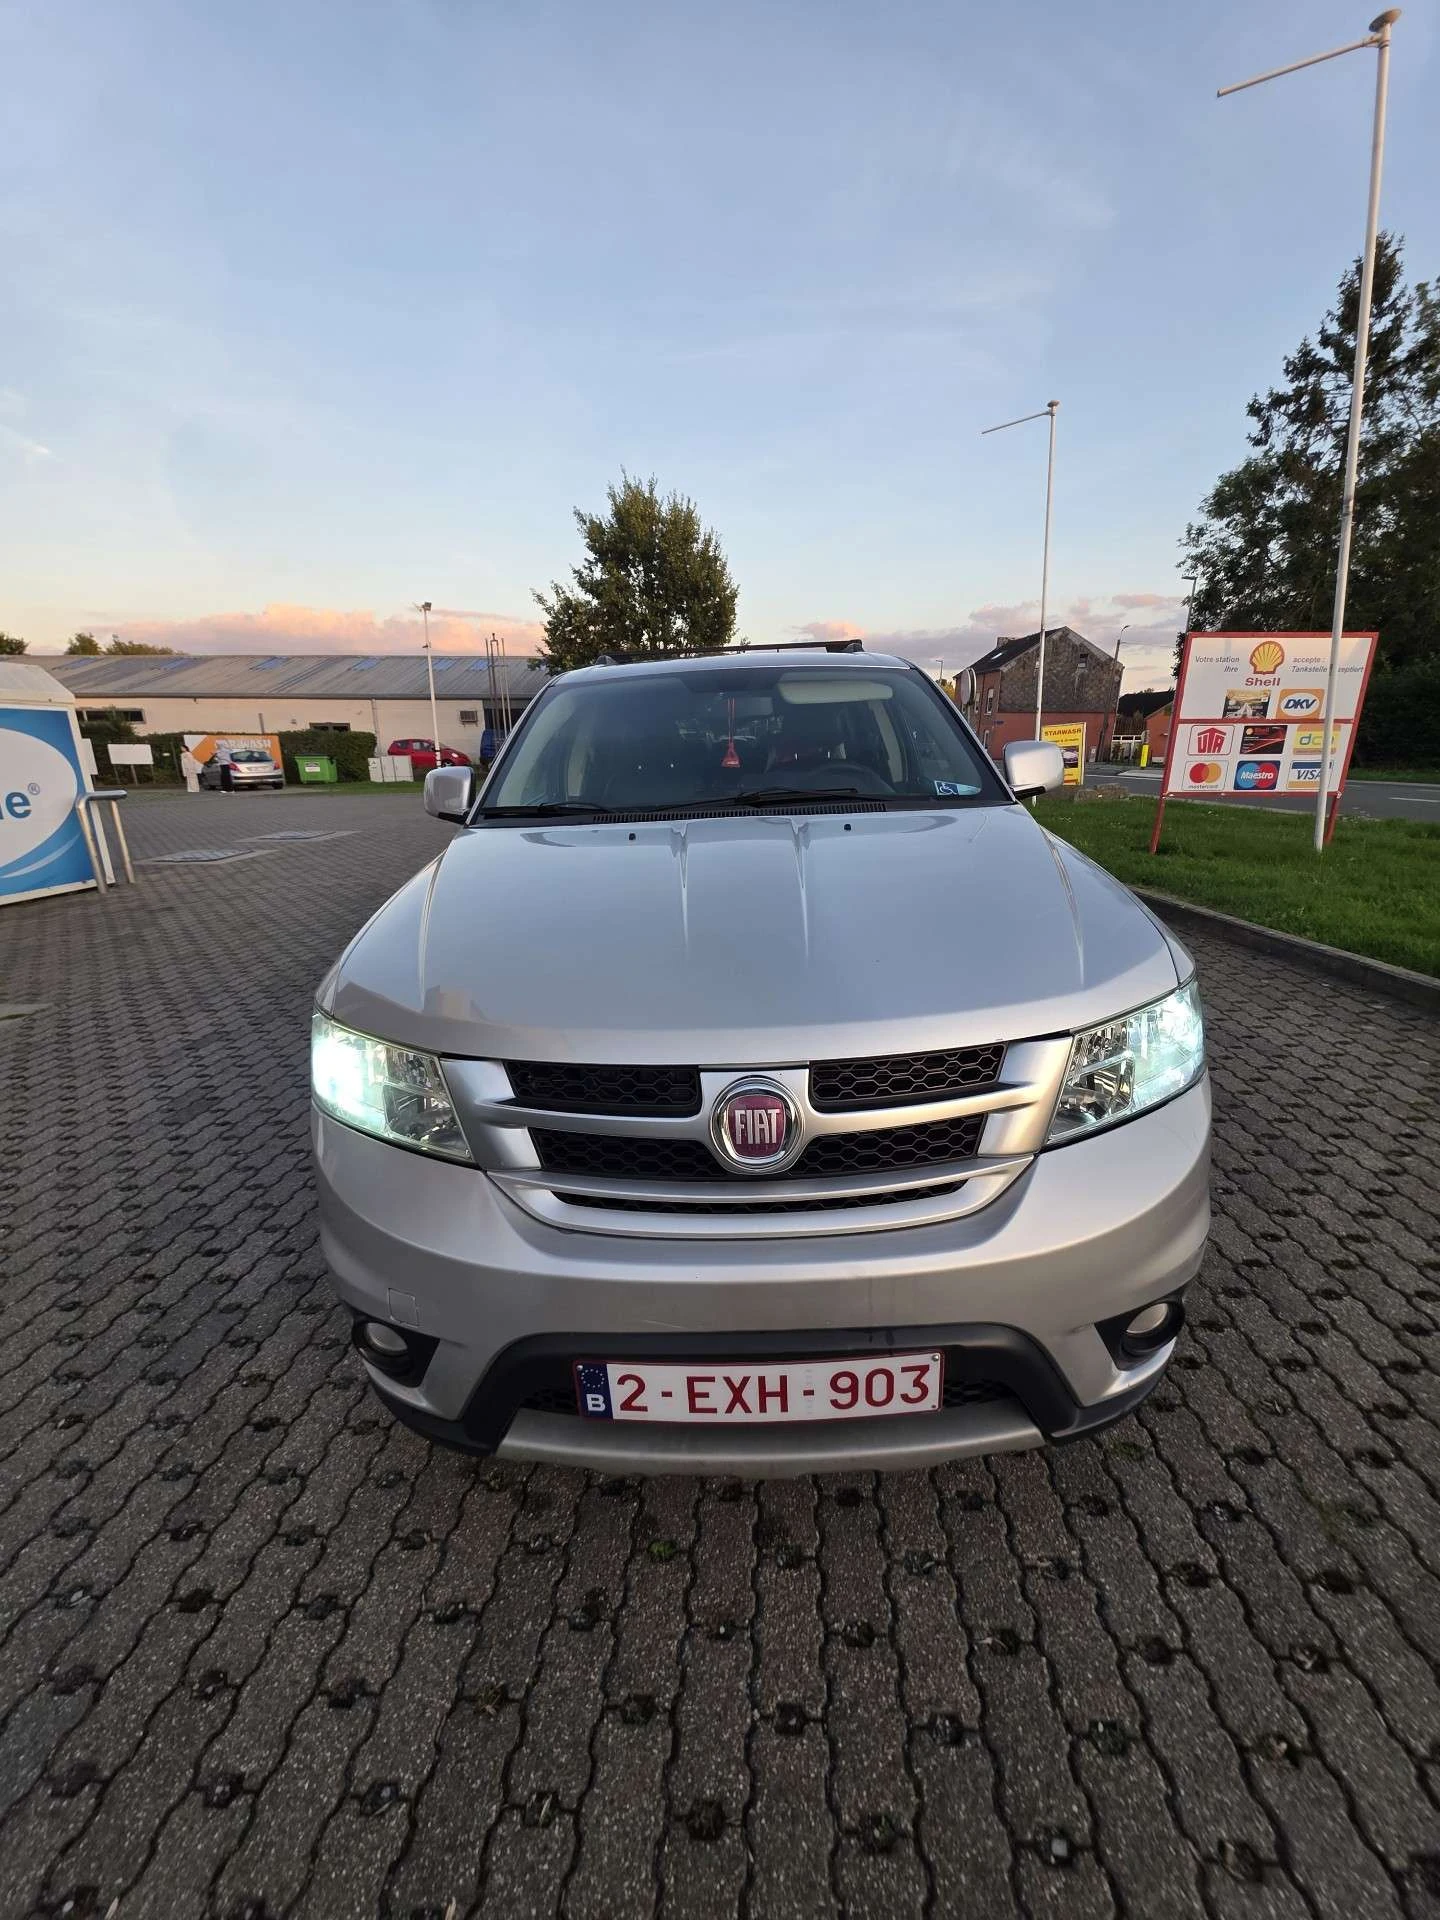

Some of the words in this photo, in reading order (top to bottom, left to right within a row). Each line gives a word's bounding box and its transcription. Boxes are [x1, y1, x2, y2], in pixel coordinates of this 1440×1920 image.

[1291, 665, 1328, 673] Tankstelle
[1245, 677, 1281, 687] Shell
[1284, 698, 1317, 710] DKV
[1044, 728, 1082, 737] STARWASH
[1240, 771, 1274, 780] Maestro
[734, 1108, 781, 1145] FIAT
[616, 1363, 931, 1415] 2-EXH-903
[586, 1393, 607, 1413] B
